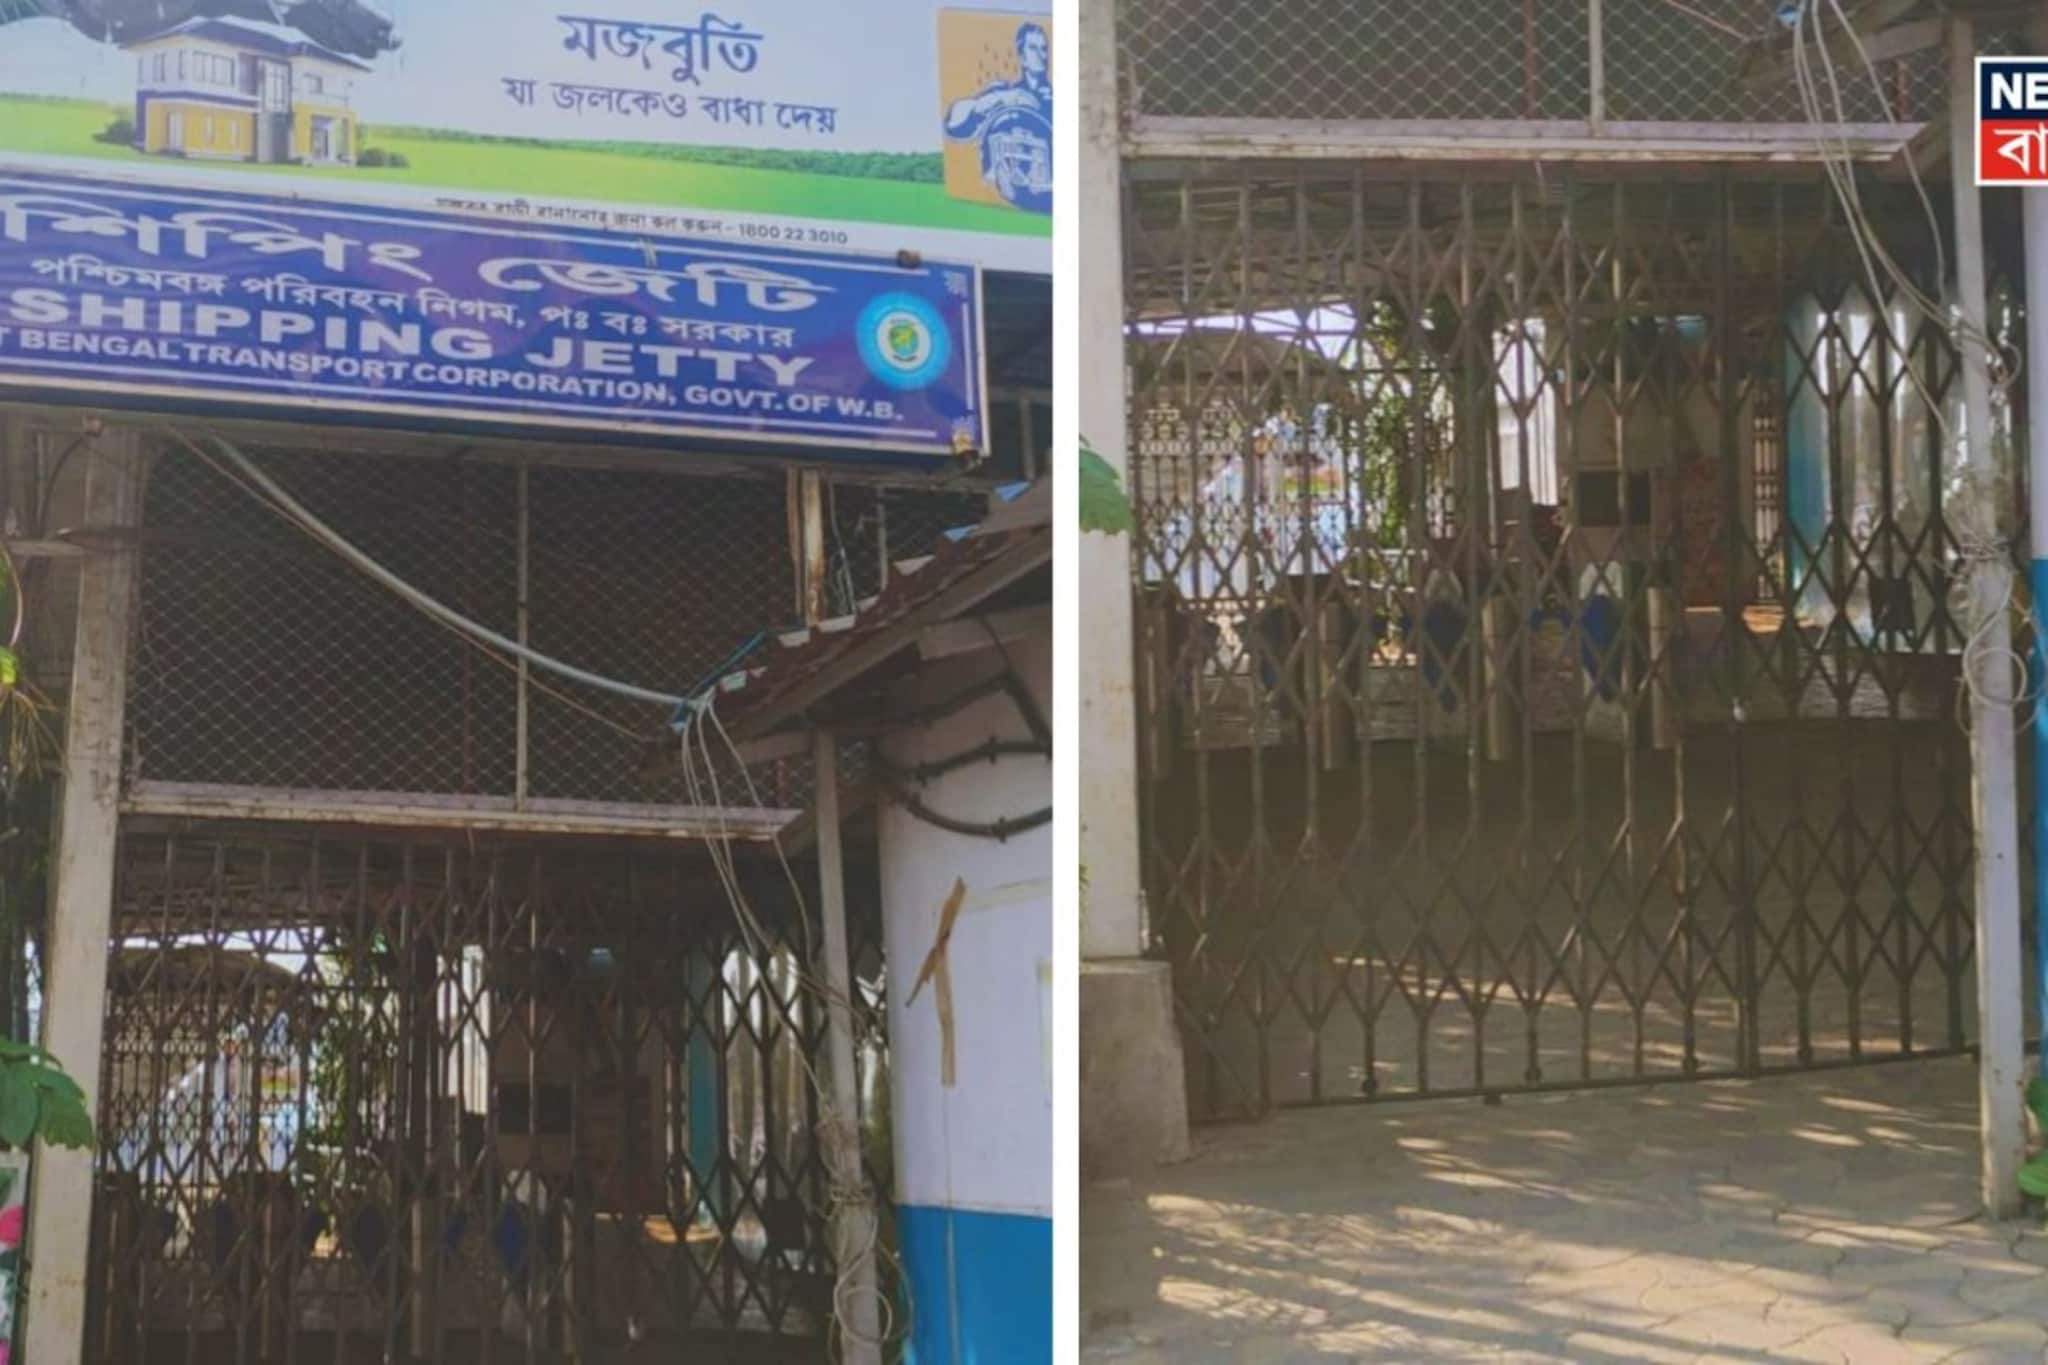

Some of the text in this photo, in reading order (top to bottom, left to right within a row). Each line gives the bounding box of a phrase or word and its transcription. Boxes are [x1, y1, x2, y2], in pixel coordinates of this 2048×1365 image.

[557, 13, 763, 86] মজবুতি
[503, 76, 838, 134] যা জলকেও বাধা দেয়
[738, 223, 780, 239] 1800
[784, 226, 804, 241] 22
[31, 253, 227, 297] পশ্চিমবঙ্গ
[241, 272, 406, 314] পরিবহন
[658, 315, 796, 349] সরকার
[478, 255, 838, 312] জেটি
[9, 287, 815, 386] SHIPPING JETTY
[20, 328, 182, 361] BENGAL
[183, 342, 410, 382] TRANSPORT
